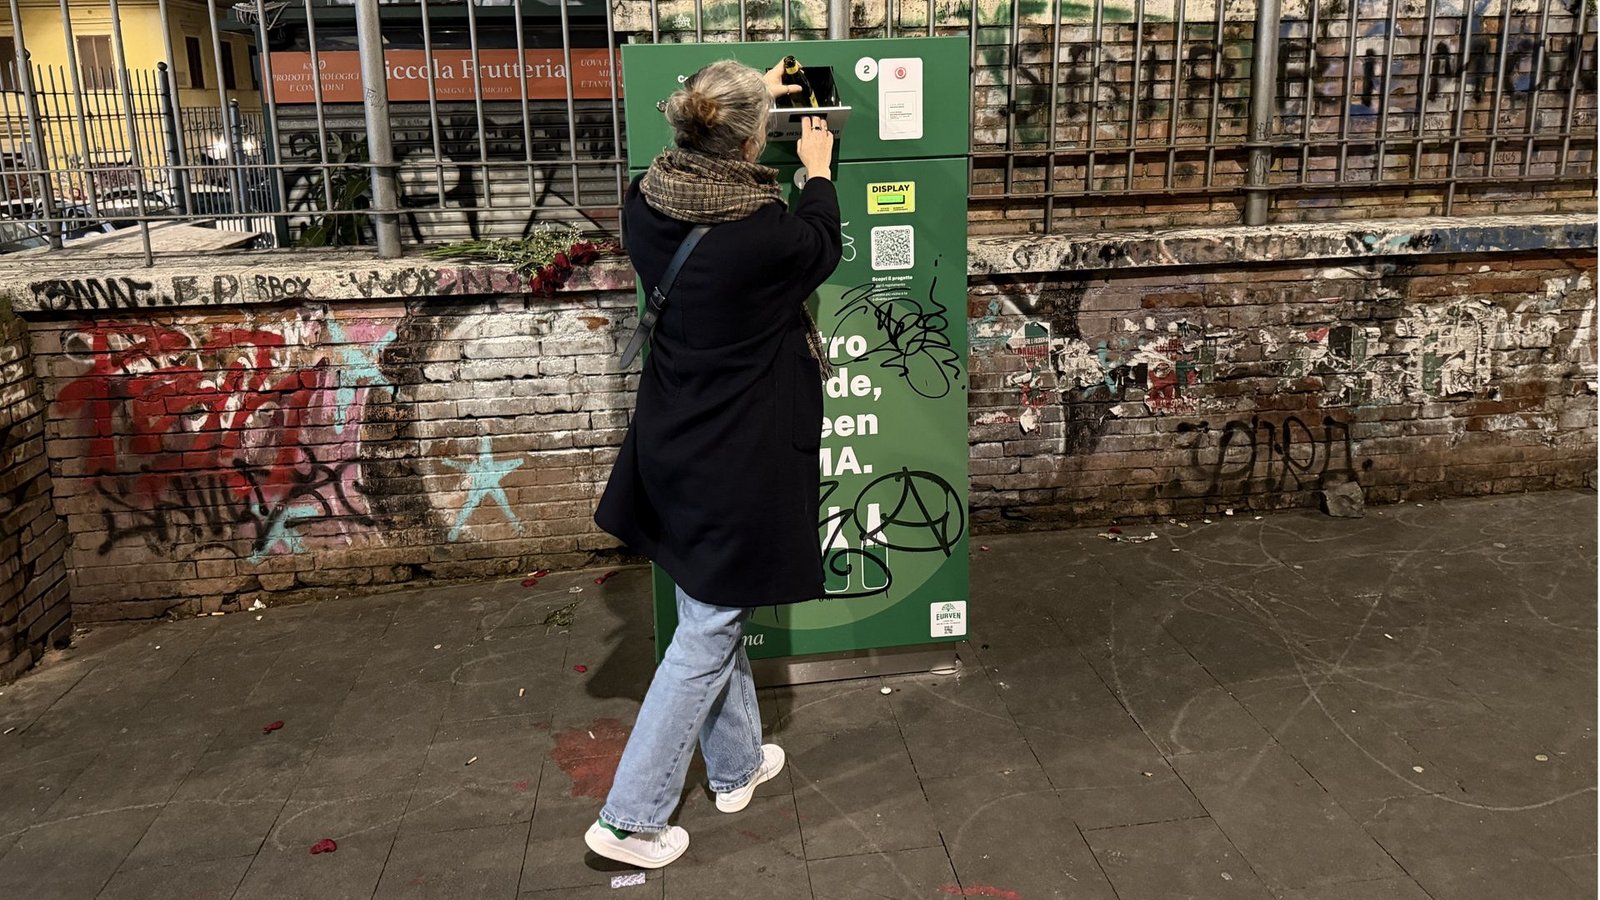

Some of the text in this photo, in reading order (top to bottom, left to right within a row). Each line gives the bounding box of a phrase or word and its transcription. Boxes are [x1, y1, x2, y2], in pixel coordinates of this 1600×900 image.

[272, 72, 360, 81] PRODOTT IOLOGICI
[384, 58, 454, 80] iccola
[863, 64, 870, 74] 2
[296, 83, 344, 92] CONADINI
[872, 184, 910, 193] DISPLAY
[818, 331, 868, 358] tro
[822, 367, 882, 401] de,
[821, 413, 879, 439] een
[819, 446, 873, 477] MA.
[936, 612, 962, 621] EURVEN
